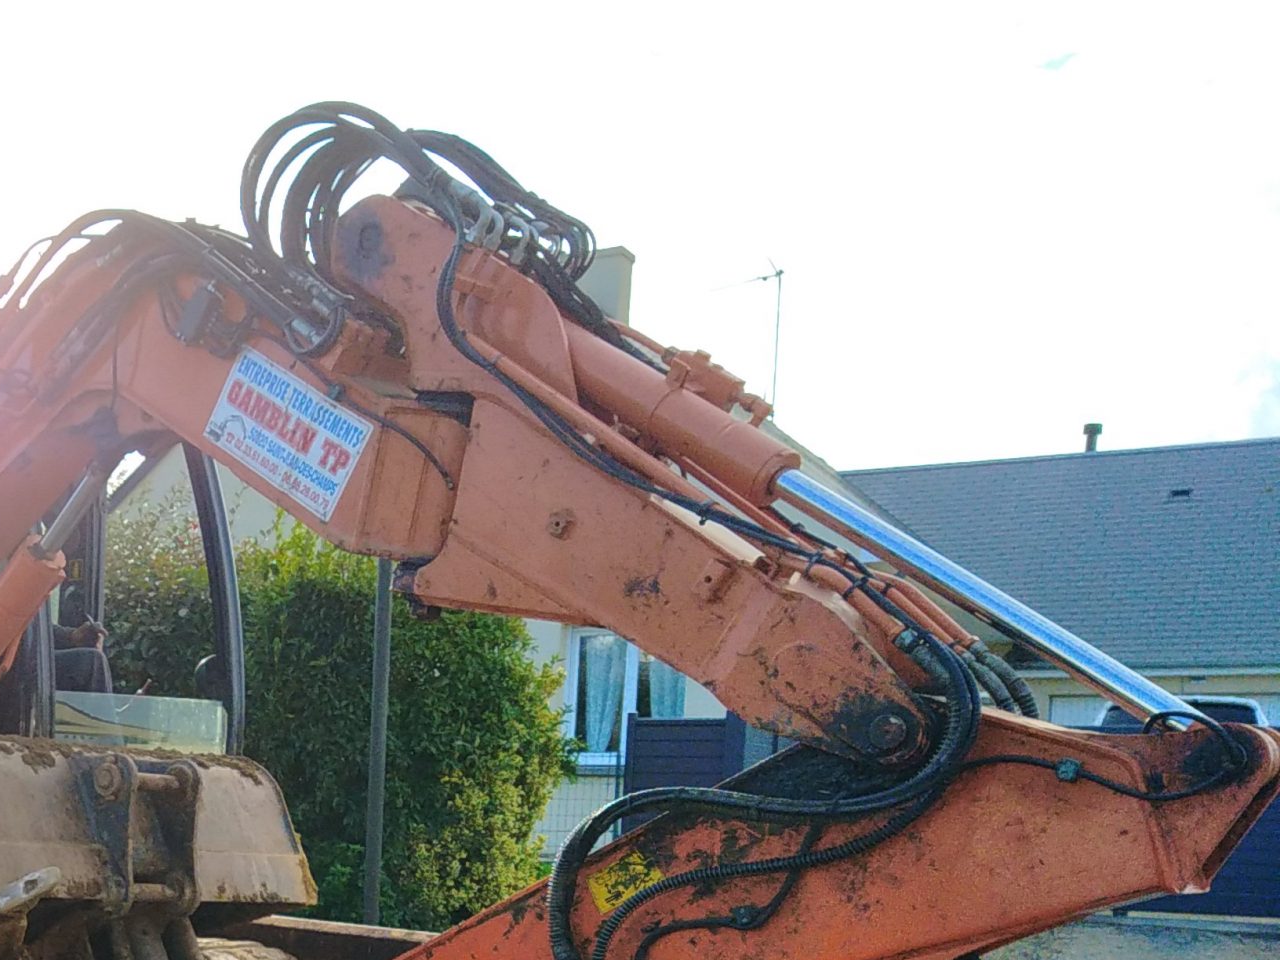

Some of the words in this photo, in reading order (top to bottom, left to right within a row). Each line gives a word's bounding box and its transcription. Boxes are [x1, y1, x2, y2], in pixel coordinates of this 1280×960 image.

[227, 378, 318, 456] GAMBLIN
[317, 440, 352, 476] TP
[237, 355, 291, 403] ENTREPRISE
[289, 386, 365, 448] TERRASSEMENTS
